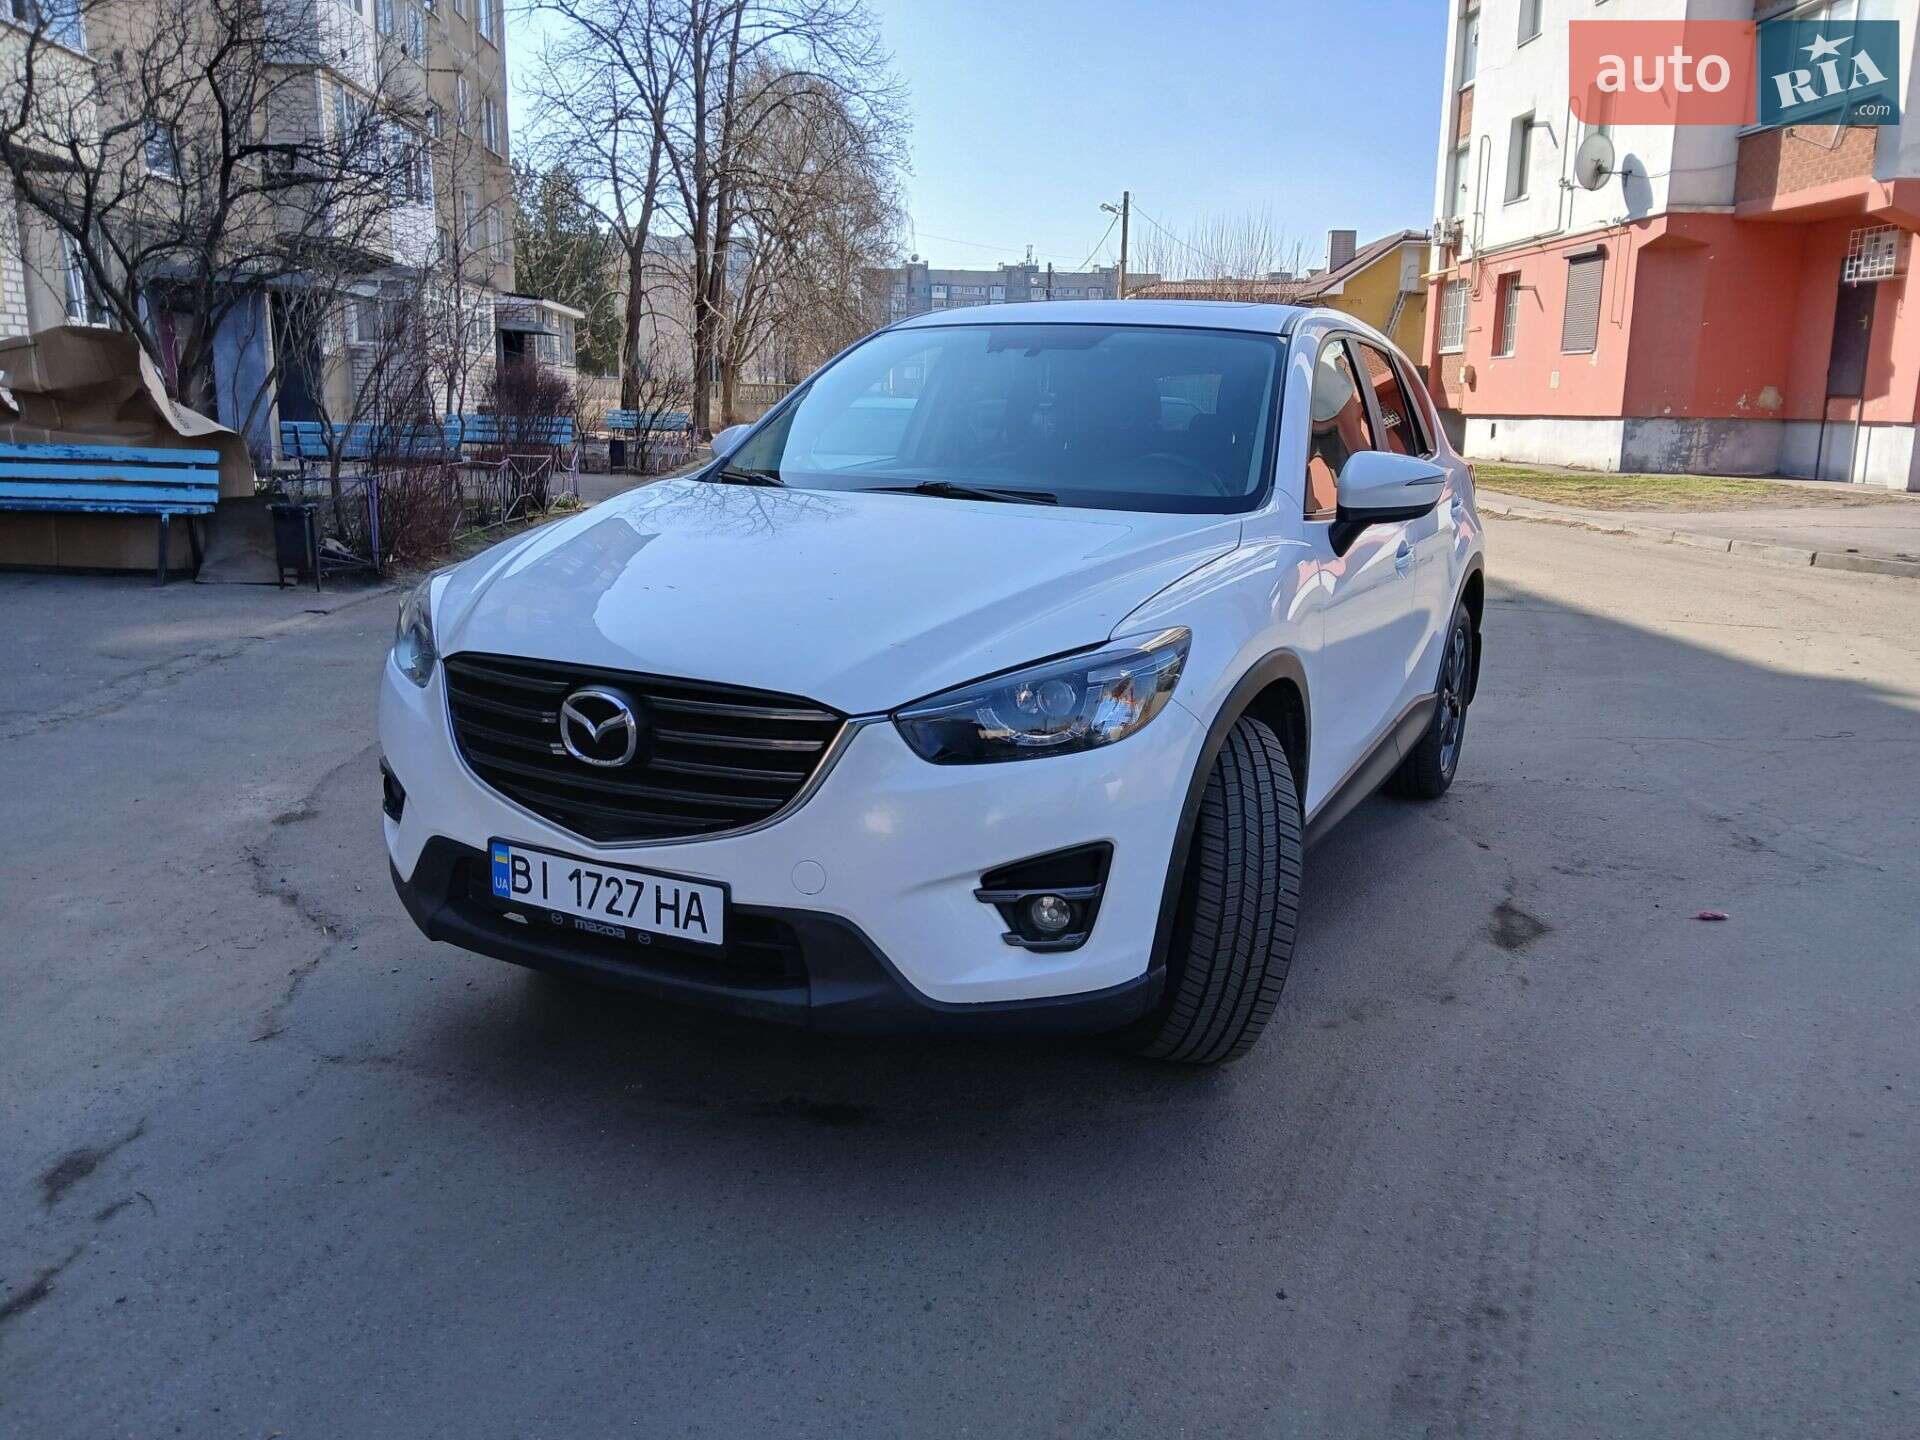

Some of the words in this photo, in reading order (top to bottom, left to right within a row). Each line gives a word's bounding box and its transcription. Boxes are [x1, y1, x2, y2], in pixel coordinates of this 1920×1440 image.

[495, 876, 509, 890] UA
[511, 855, 548, 900] BI
[568, 868, 644, 918] 1727
[655, 885, 708, 934] HA
[574, 919, 626, 939] mazda
